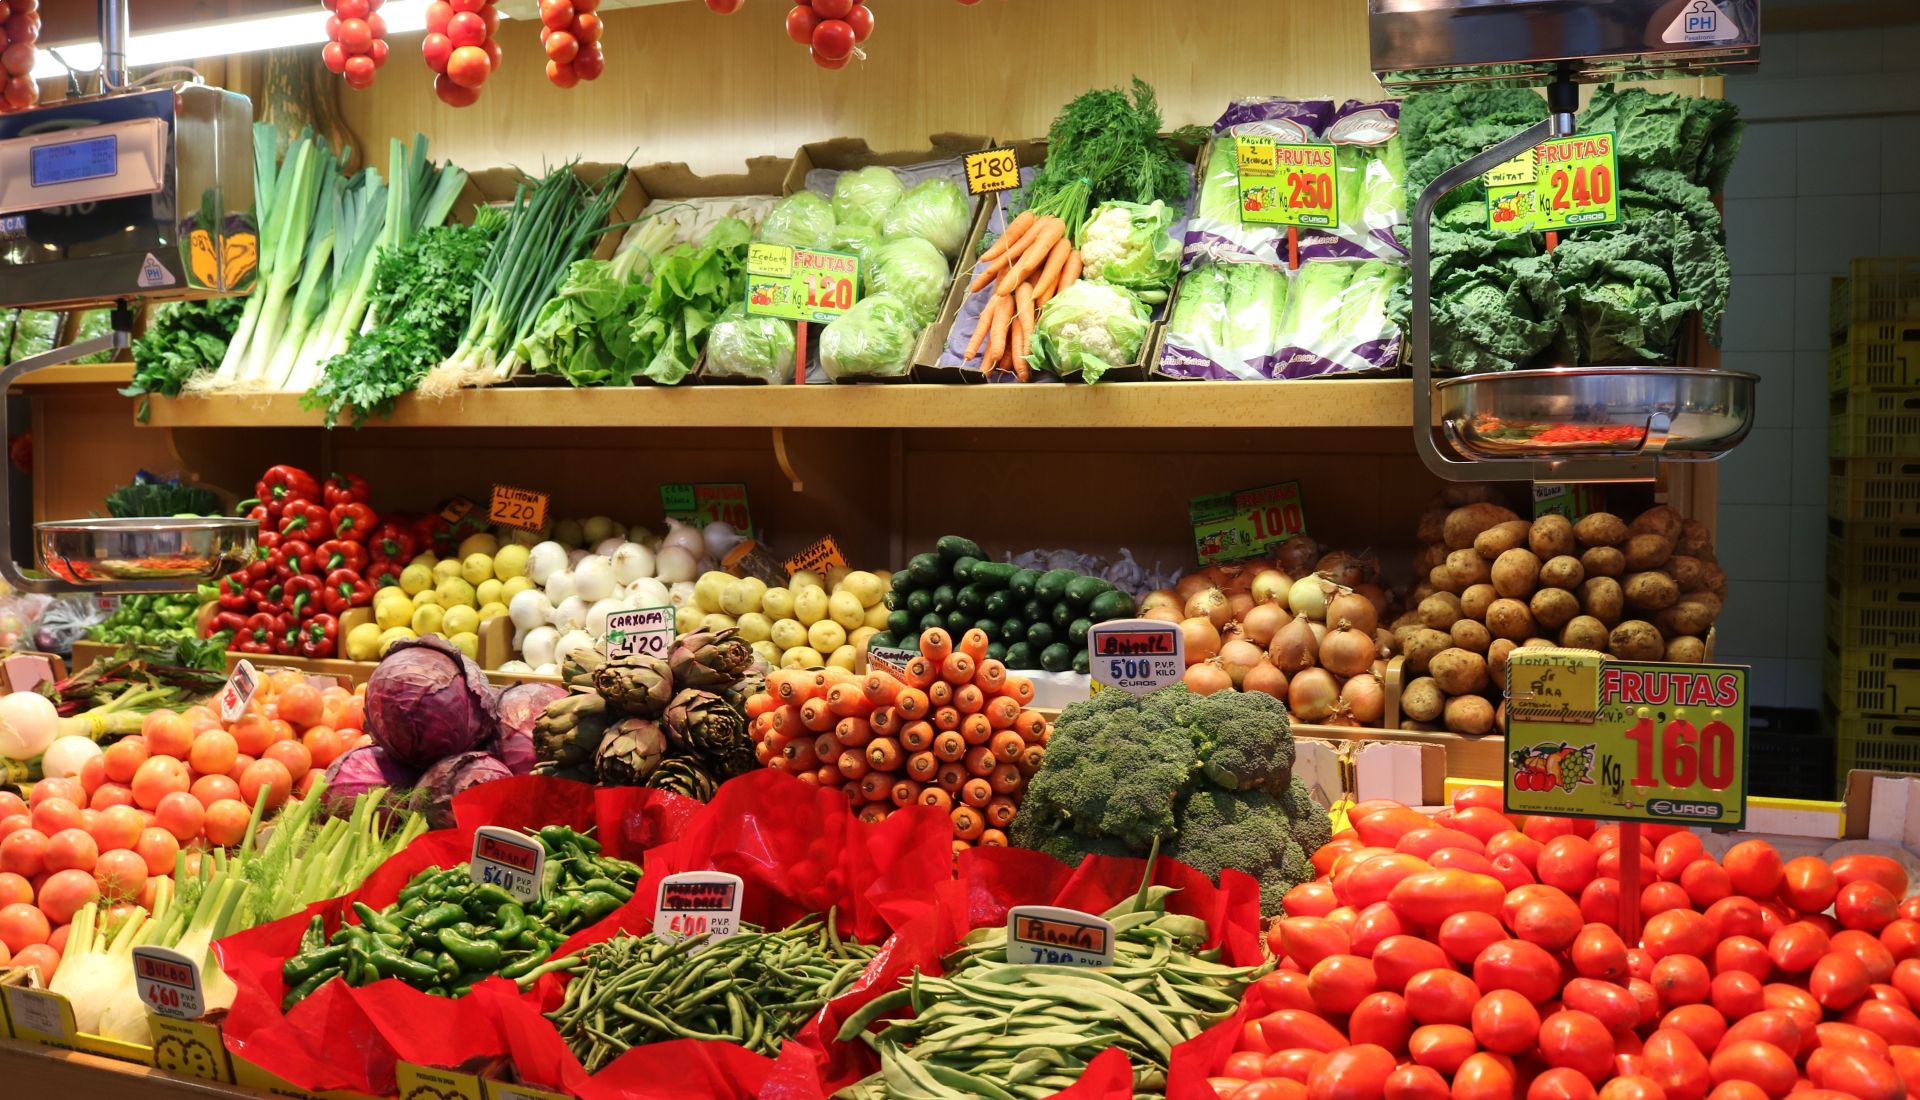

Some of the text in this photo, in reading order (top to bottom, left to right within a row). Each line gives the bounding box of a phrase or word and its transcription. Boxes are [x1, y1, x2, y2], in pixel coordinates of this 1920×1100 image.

[1689, 16, 1712, 30] PH
[1276, 148, 1332, 167] FRUTAS
[1536, 138, 1609, 165] FRUTAS
[793, 251, 856, 273] FRUTAS
[147, 268, 160, 278] PH
[1234, 484, 1298, 507] FRUTAS
[494, 501, 535, 520] 2'20
[610, 612, 662, 628] CARXOFA
[622, 635, 663, 654] 4'20
[1604, 667, 1739, 707] FRUTAS
[516, 886, 531, 895] KILO
[711, 927, 729, 935] KILO
